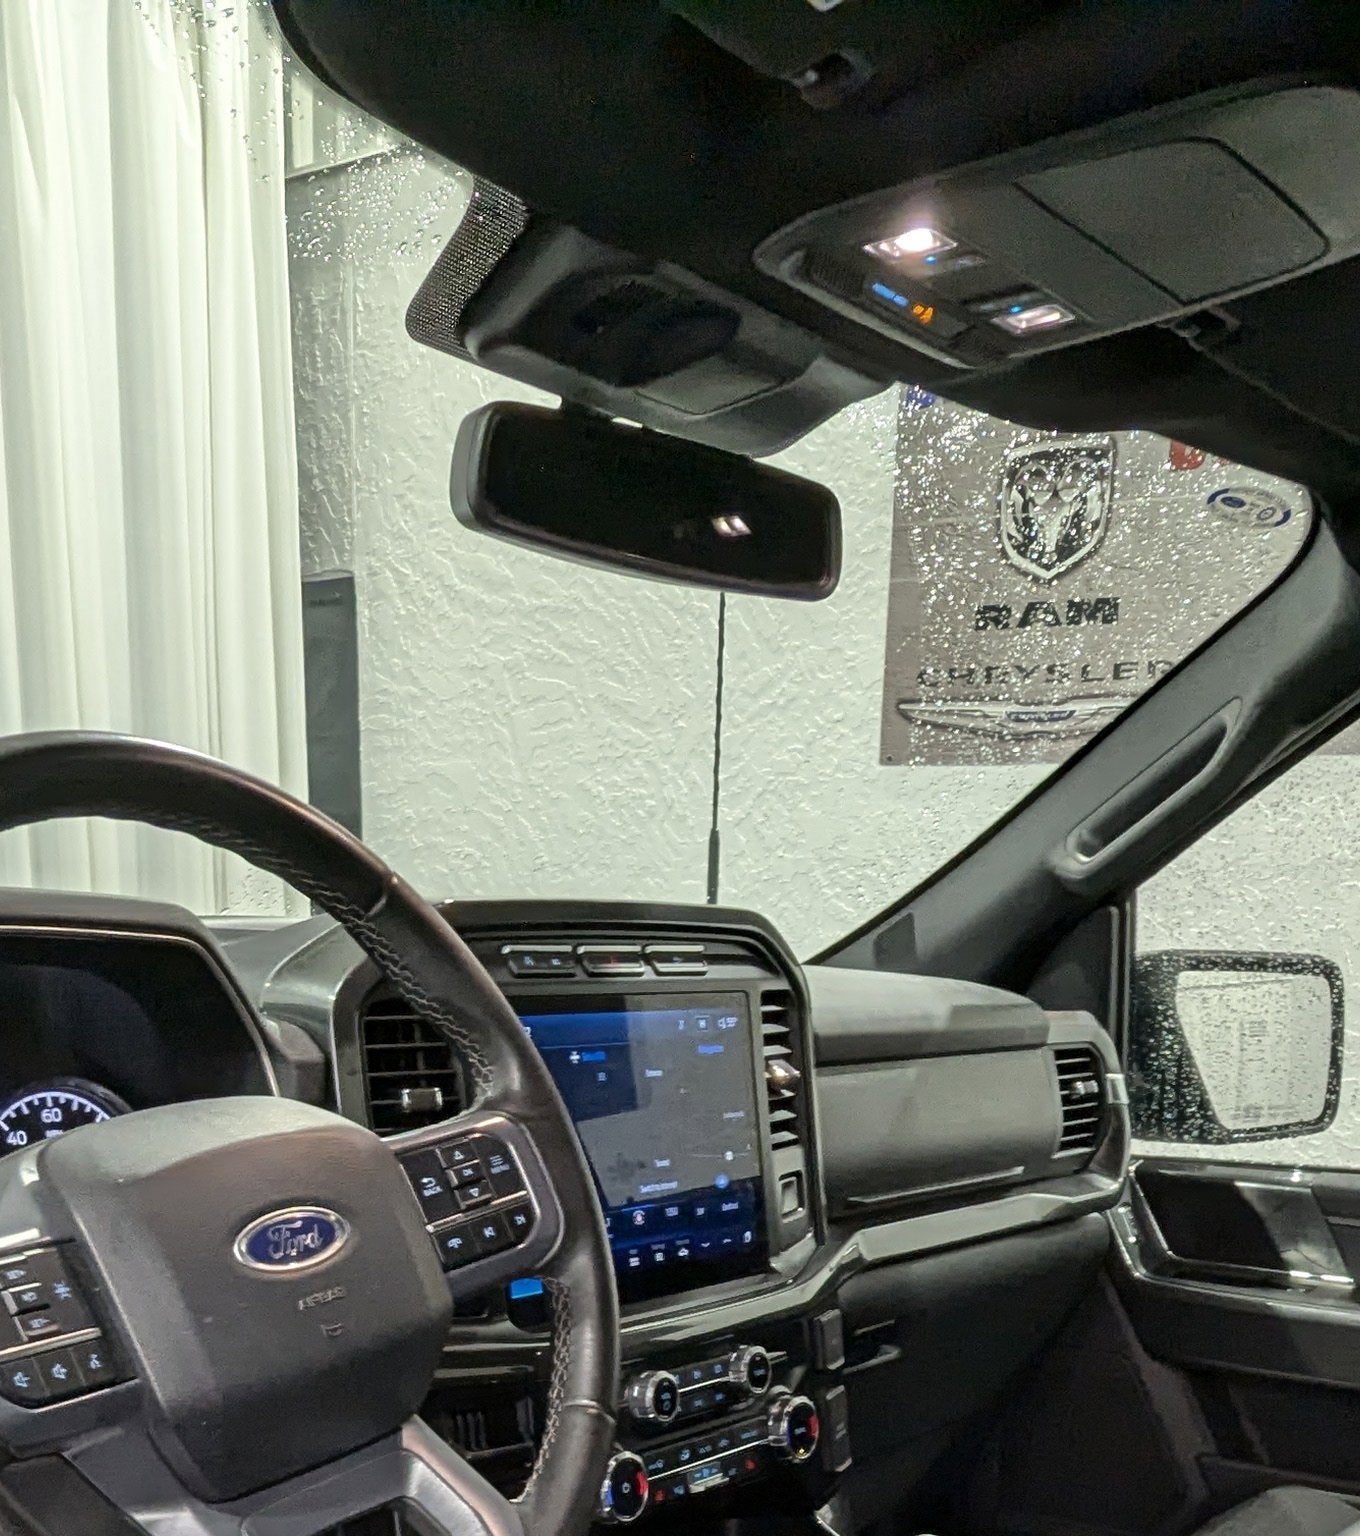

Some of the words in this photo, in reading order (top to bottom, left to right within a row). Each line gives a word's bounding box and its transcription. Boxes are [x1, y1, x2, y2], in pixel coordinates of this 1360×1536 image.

[974, 596, 1120, 631] RAM
[40, 1107, 62, 1123] 60
[6, 1130, 28, 1146] 40
[267, 1220, 324, 1260] Ford
